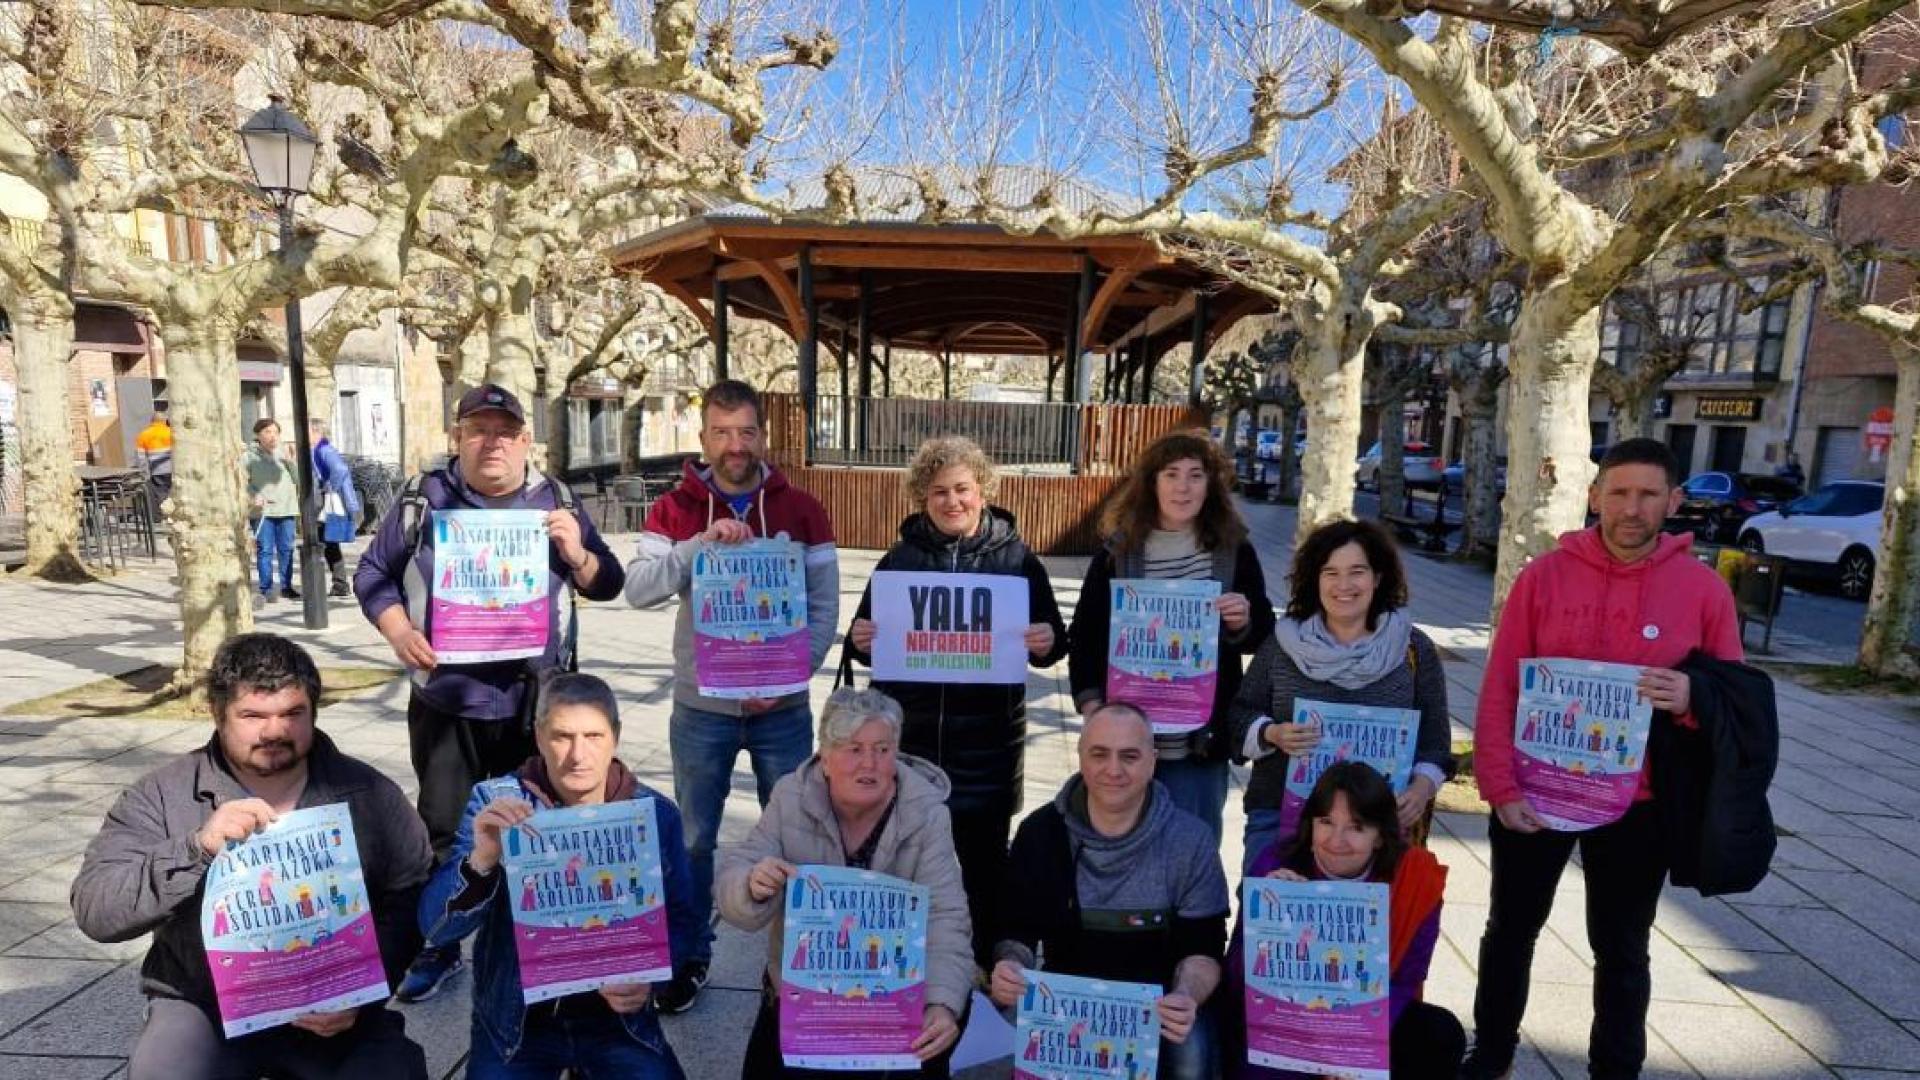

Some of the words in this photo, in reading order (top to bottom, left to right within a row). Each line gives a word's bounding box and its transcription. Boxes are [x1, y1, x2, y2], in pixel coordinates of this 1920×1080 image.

[908, 585, 993, 633] YALA
[906, 631, 993, 654] NAFARROA
[928, 654, 993, 670] PALESTINA
[281, 850, 335, 882] AZOKA
[860, 910, 906, 930] AZOKA
[1317, 923, 1367, 943] AZOKA
